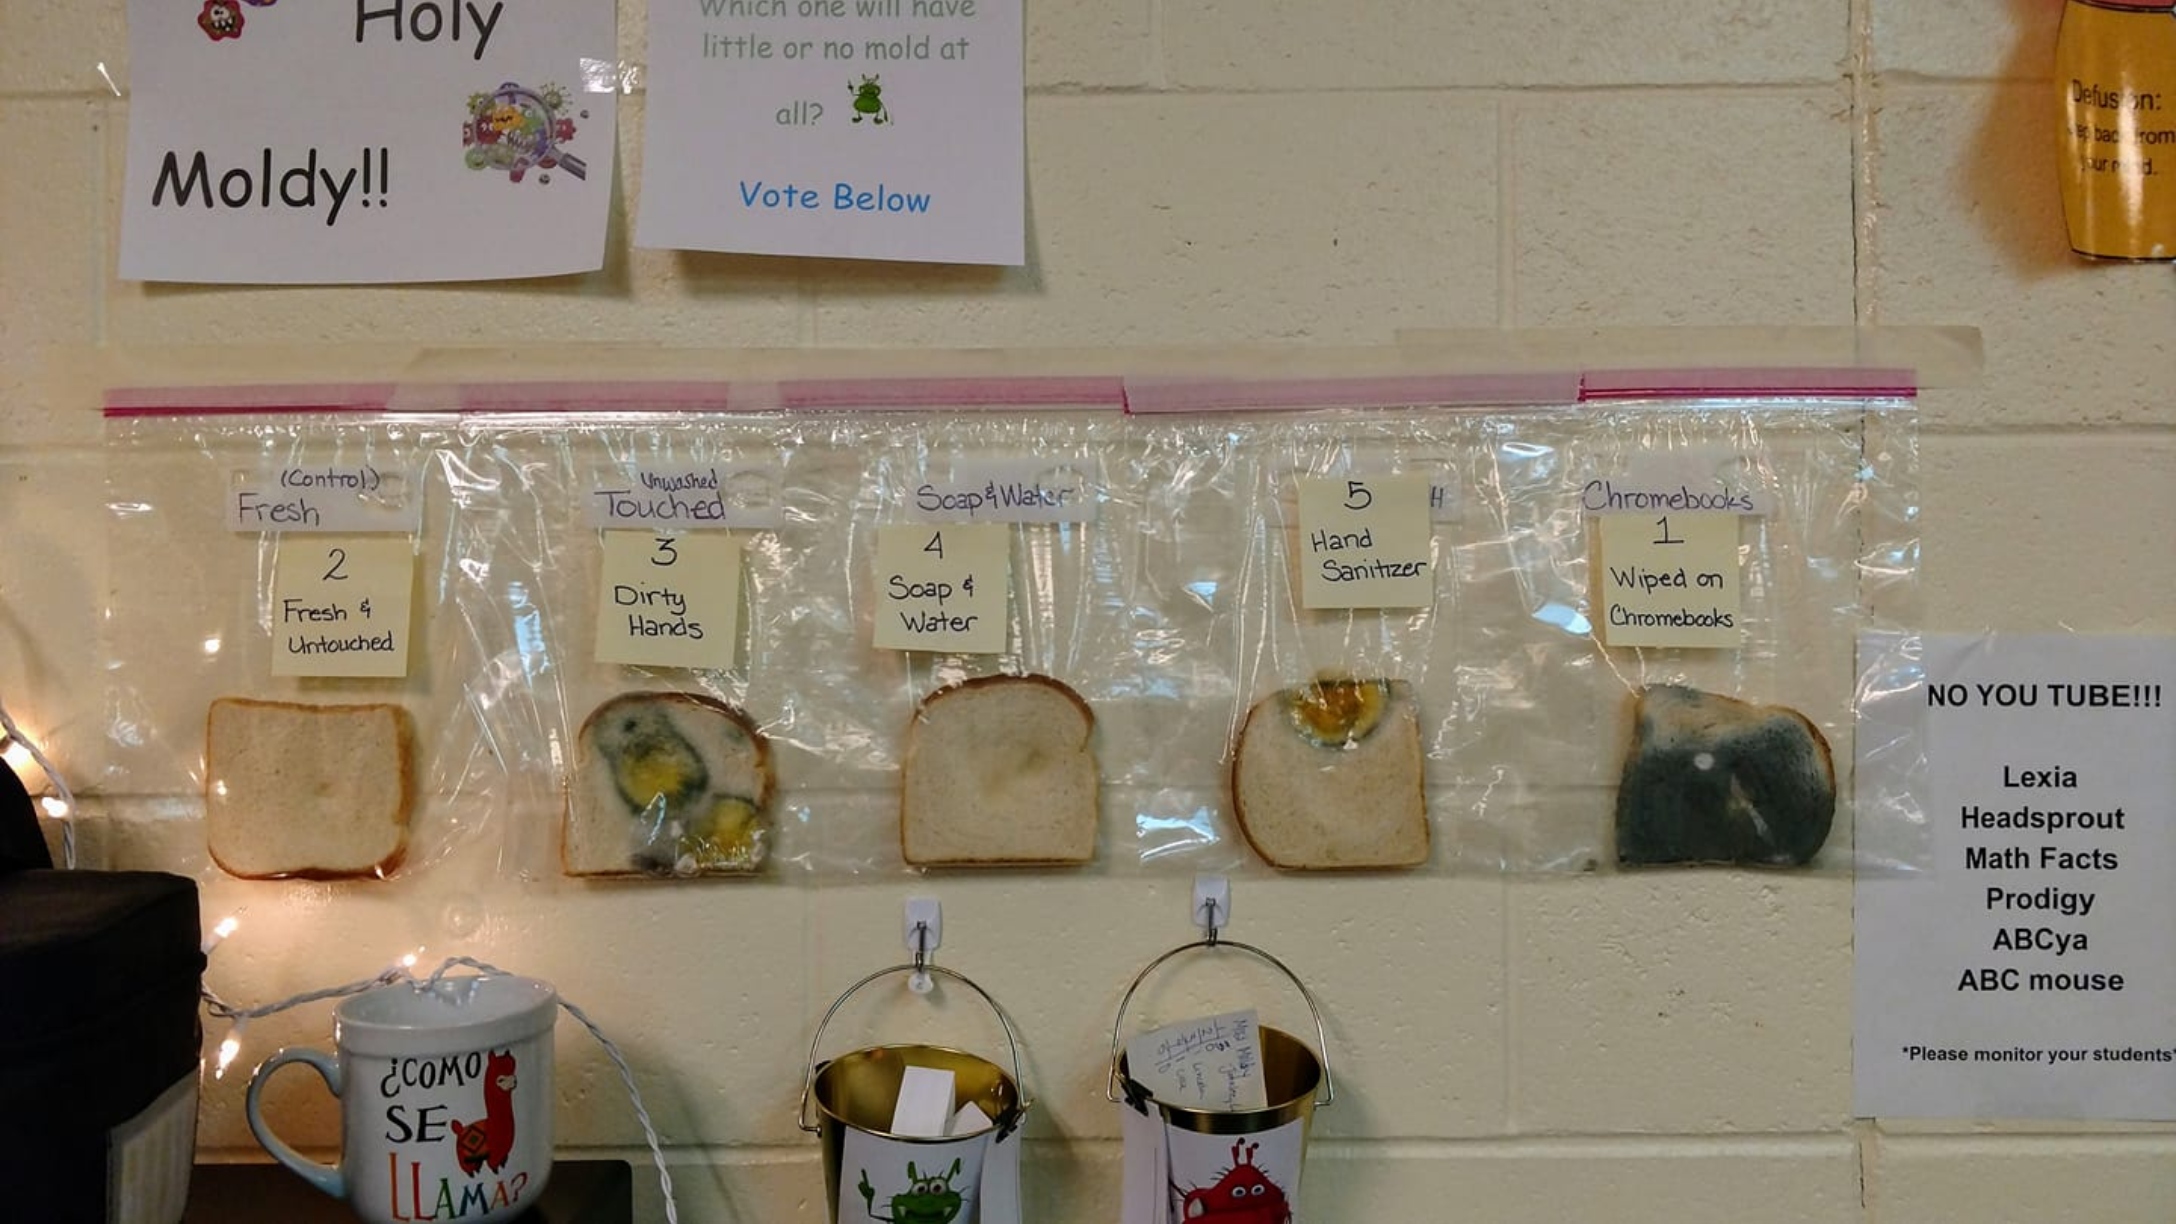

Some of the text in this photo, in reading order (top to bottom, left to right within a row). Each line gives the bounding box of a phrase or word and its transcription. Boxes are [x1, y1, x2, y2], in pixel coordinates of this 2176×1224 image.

[700, 0, 977, 18] Which one will have
[354, 0, 508, 60] Holy
[702, 33, 971, 61] little or no mold at
[2072, 79, 2163, 112] Defuson:
[775, 101, 825, 127] all?
[2094, 125, 2126, 144] bac
[2135, 127, 2176, 146] rom
[151, 147, 389, 227] Moldy!!
[739, 181, 931, 214] Vote Below
[280, 466, 381, 491] (Control)
[640, 468, 718, 493] Unwashed
[238, 492, 320, 527] Fresh
[593, 489, 727, 520] Touched
[1343, 480, 1373, 511] 5
[1582, 479, 1754, 512] Chromebooks
[1311, 527, 1374, 553] Hand
[1652, 515, 1685, 545] 1
[651, 537, 678, 566] 3
[923, 531, 944, 560] 4
[322, 548, 349, 581] 2
[1321, 557, 1428, 582] Sanitizer
[888, 574, 953, 606] Soap
[1610, 566, 1724, 595] Wiped on
[283, 598, 348, 624] Fresh
[614, 581, 687, 616] Dirty
[629, 614, 704, 640] Hands
[900, 610, 979, 634] Water
[1610, 603, 1734, 629] Chromebooks
[288, 630, 395, 655] Untouched
[1927, 684, 2162, 708] NO YOU TUBE!!!
[2003, 765, 2078, 788] Lexia
[1961, 806, 2126, 834] Headsprout
[1965, 847, 2119, 870] Math Facts
[1986, 887, 2096, 916] Prodigy
[1992, 928, 2088, 956] ABCya
[1957, 968, 2125, 992] ABC mouse
[1974, 1046, 2043, 1062] monitor
[2048, 1050, 2088, 1064] your
[380, 1051, 482, 1098] ¿COMO
[385, 1104, 449, 1144] SE
[388, 1151, 528, 1223] LLAMA?
